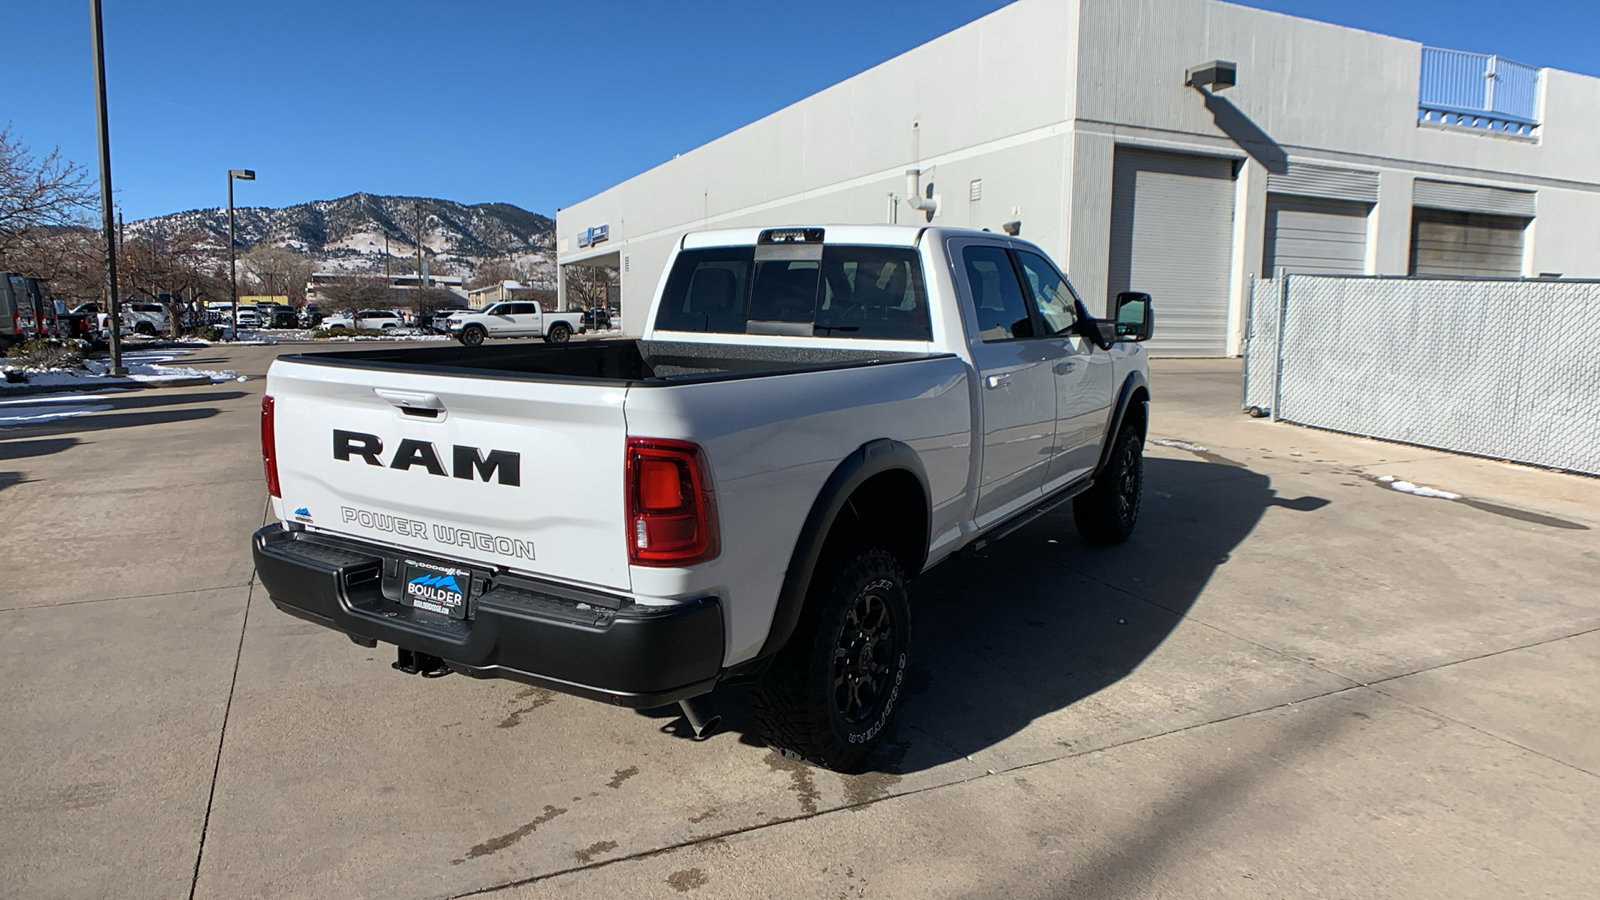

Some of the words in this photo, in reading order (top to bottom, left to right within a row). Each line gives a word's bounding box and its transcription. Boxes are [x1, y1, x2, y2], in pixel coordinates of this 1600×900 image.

[333, 429, 520, 487] RAM
[341, 506, 428, 540] POWER
[433, 524, 536, 561] WAGON
[407, 582, 462, 606] BOULDER
